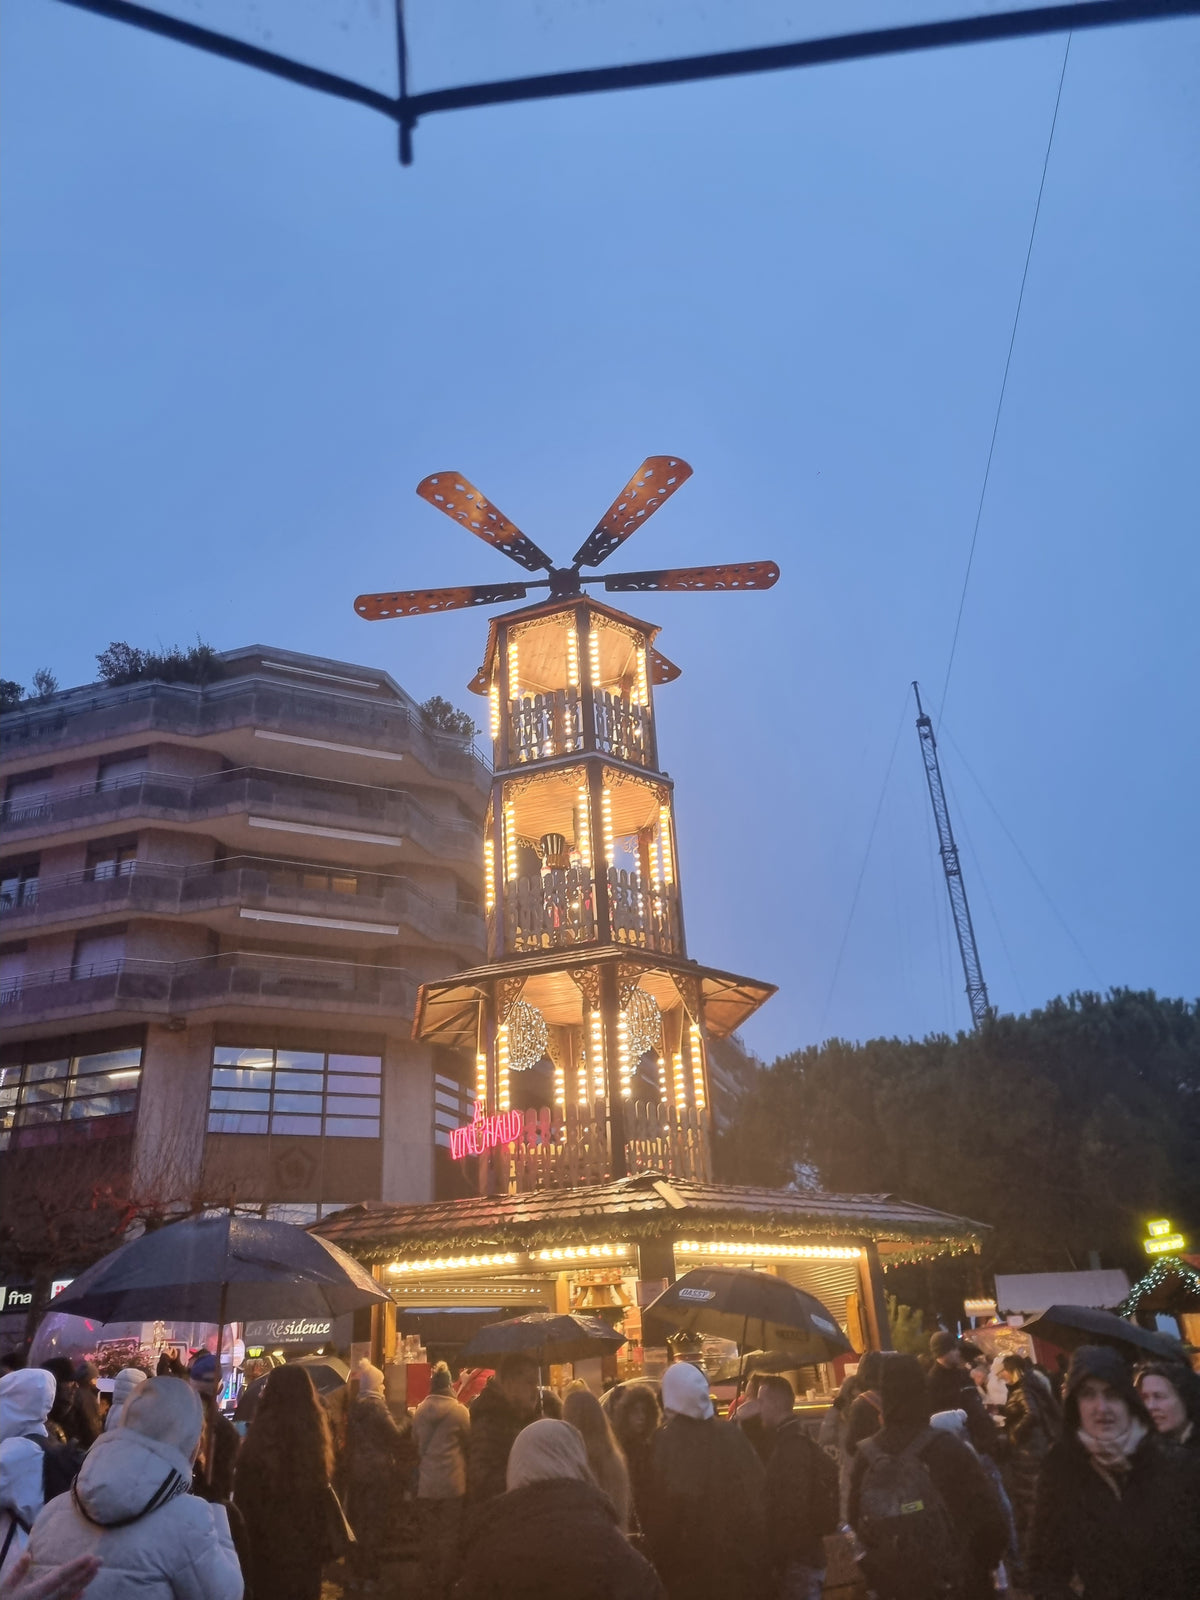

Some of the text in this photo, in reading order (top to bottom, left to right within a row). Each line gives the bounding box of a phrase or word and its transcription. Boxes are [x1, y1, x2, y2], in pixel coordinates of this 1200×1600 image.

[450, 1109, 521, 1160] VIN CHAUD
[265, 1318, 330, 1338] Résidence
